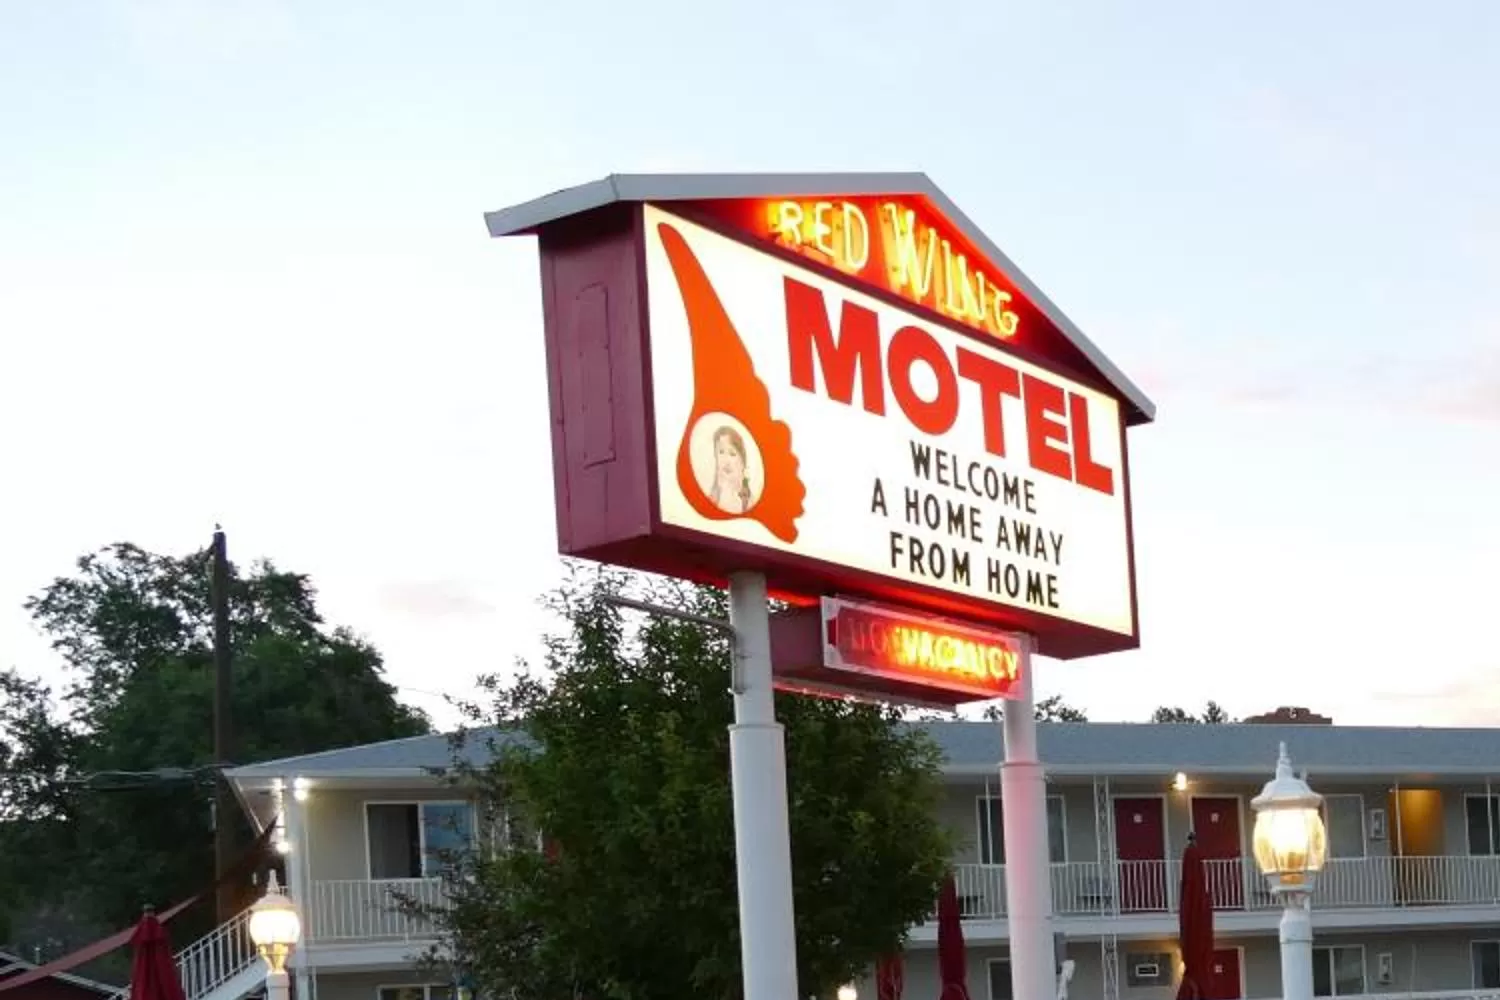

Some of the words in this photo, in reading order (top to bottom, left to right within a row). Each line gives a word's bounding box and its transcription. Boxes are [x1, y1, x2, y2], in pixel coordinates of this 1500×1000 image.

[778, 200, 870, 270] RED
[884, 202, 1021, 337] WING
[782, 275, 1115, 496] MOTEL
[910, 439, 1037, 514] WELCOME
[871, 477, 888, 518] A
[905, 486, 983, 544] HOME
[996, 515, 1063, 566] AWAY
[890, 531, 971, 587] FROM
[988, 556, 1060, 608] HOME
[895, 625, 1018, 680] VACANCY
